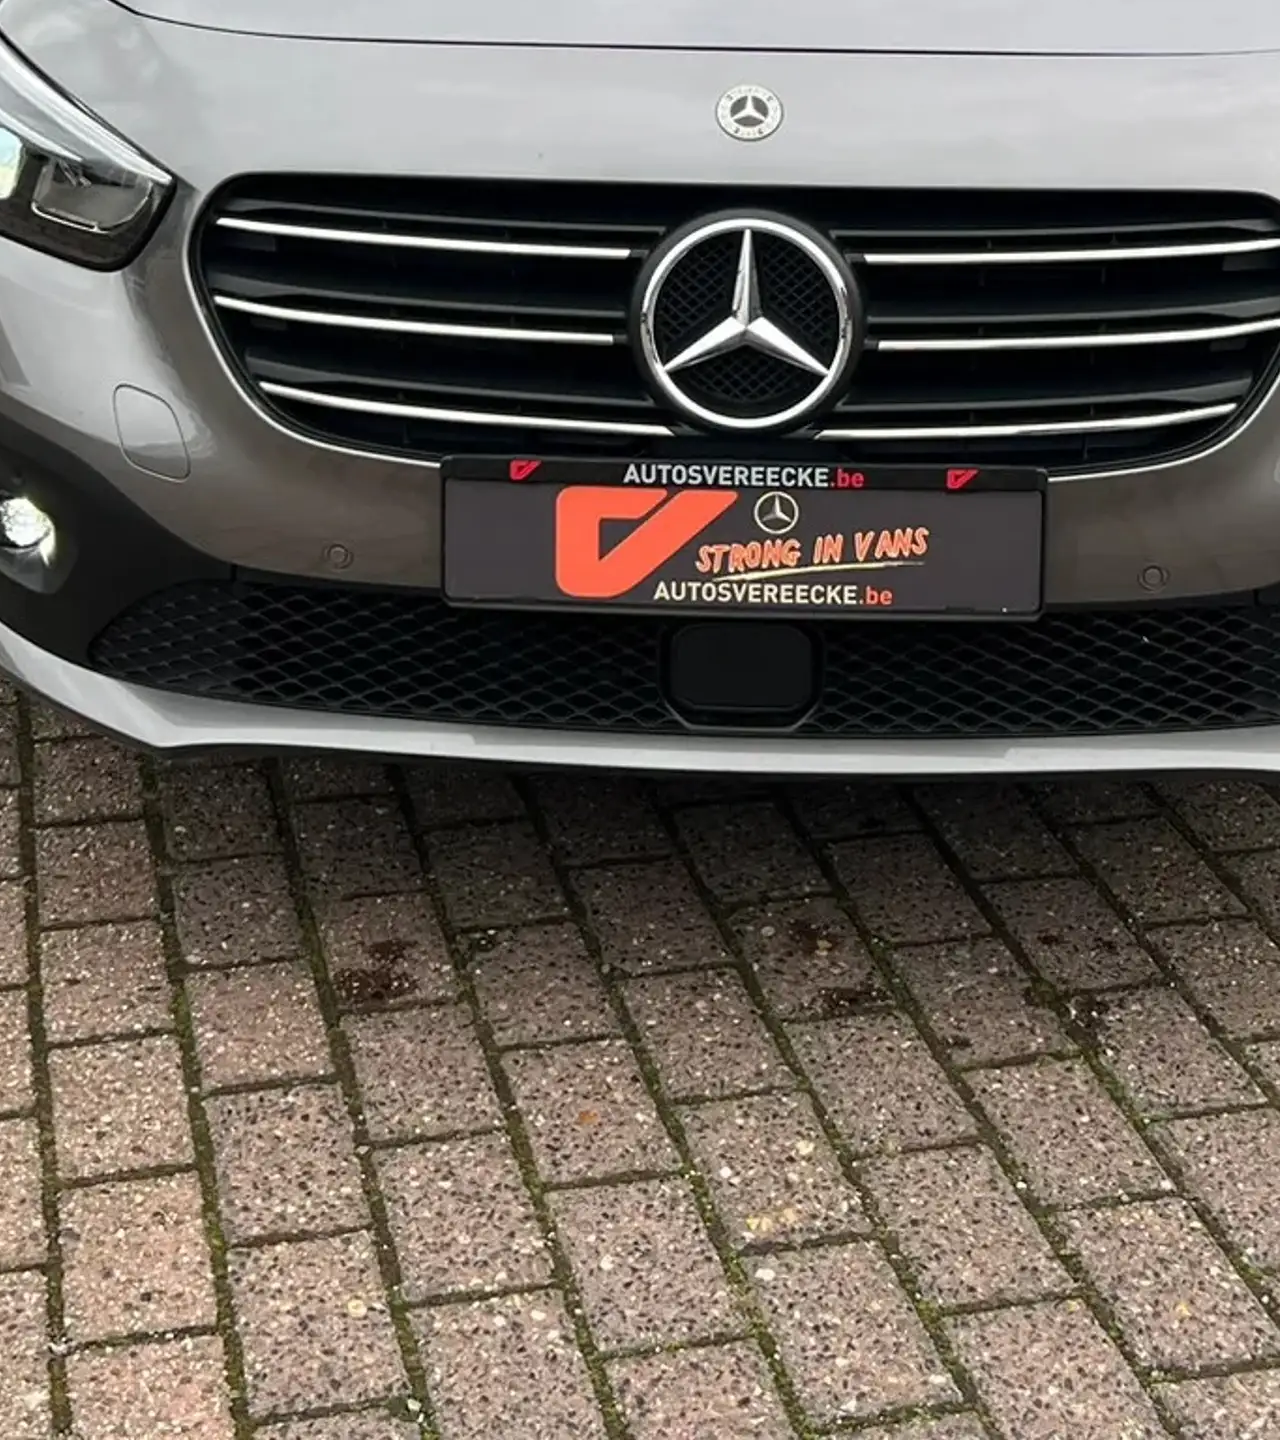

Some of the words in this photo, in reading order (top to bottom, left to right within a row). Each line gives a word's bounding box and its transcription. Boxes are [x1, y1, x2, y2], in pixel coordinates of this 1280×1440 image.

[623, 462, 864, 488] AUTOSVEREECKE.be
[695, 536, 801, 574] STRONG
[814, 532, 844, 565] IN
[853, 526, 929, 562] VANS
[653, 580, 892, 606] AUTOSVEREECKE.be
